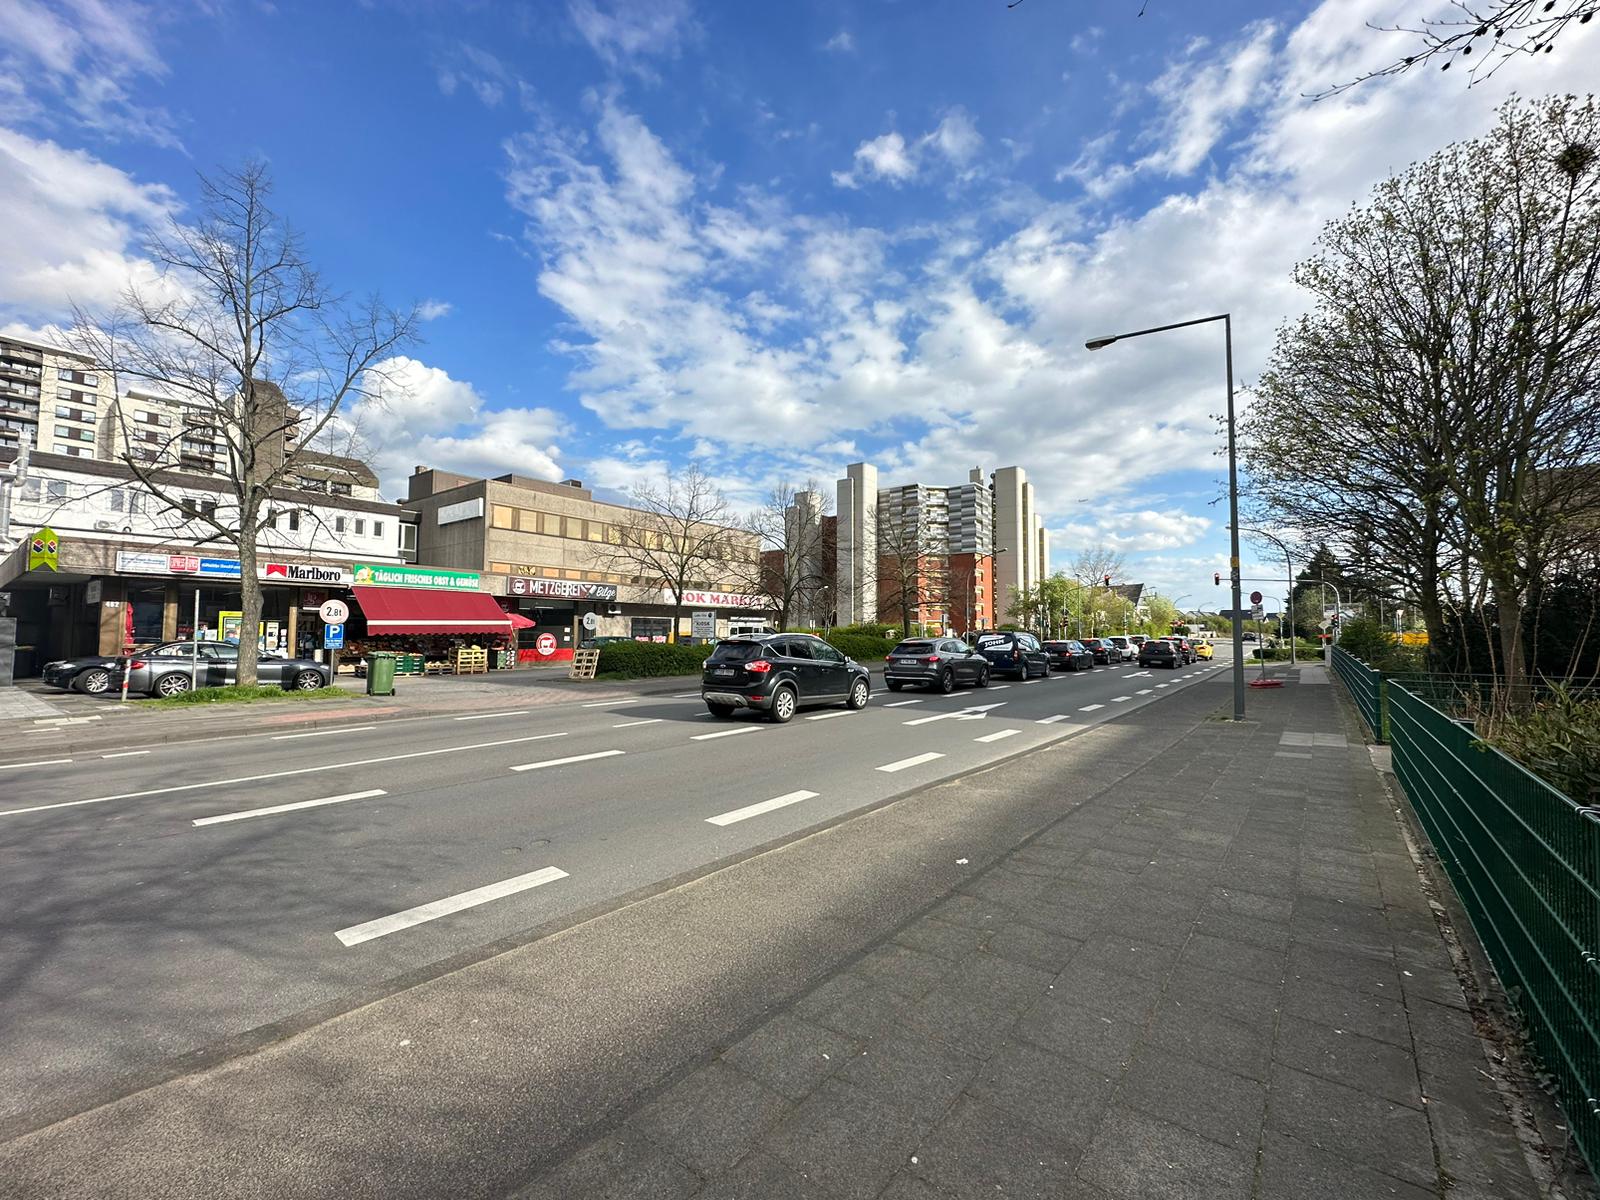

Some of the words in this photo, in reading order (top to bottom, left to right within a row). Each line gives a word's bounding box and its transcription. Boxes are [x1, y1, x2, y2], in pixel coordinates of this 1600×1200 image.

[288, 565, 341, 582] Marlboro
[374, 570, 403, 583] TÄGLICH
[404, 573, 433, 584] FRISCHES
[433, 575, 449, 586] OBST
[456, 575, 479, 588] GEMÜSE
[529, 580, 581, 597] METZGEREI
[596, 586, 616, 600] Bilge
[326, 606, 342, 617] 2.8t
[329, 625, 341, 639] P
